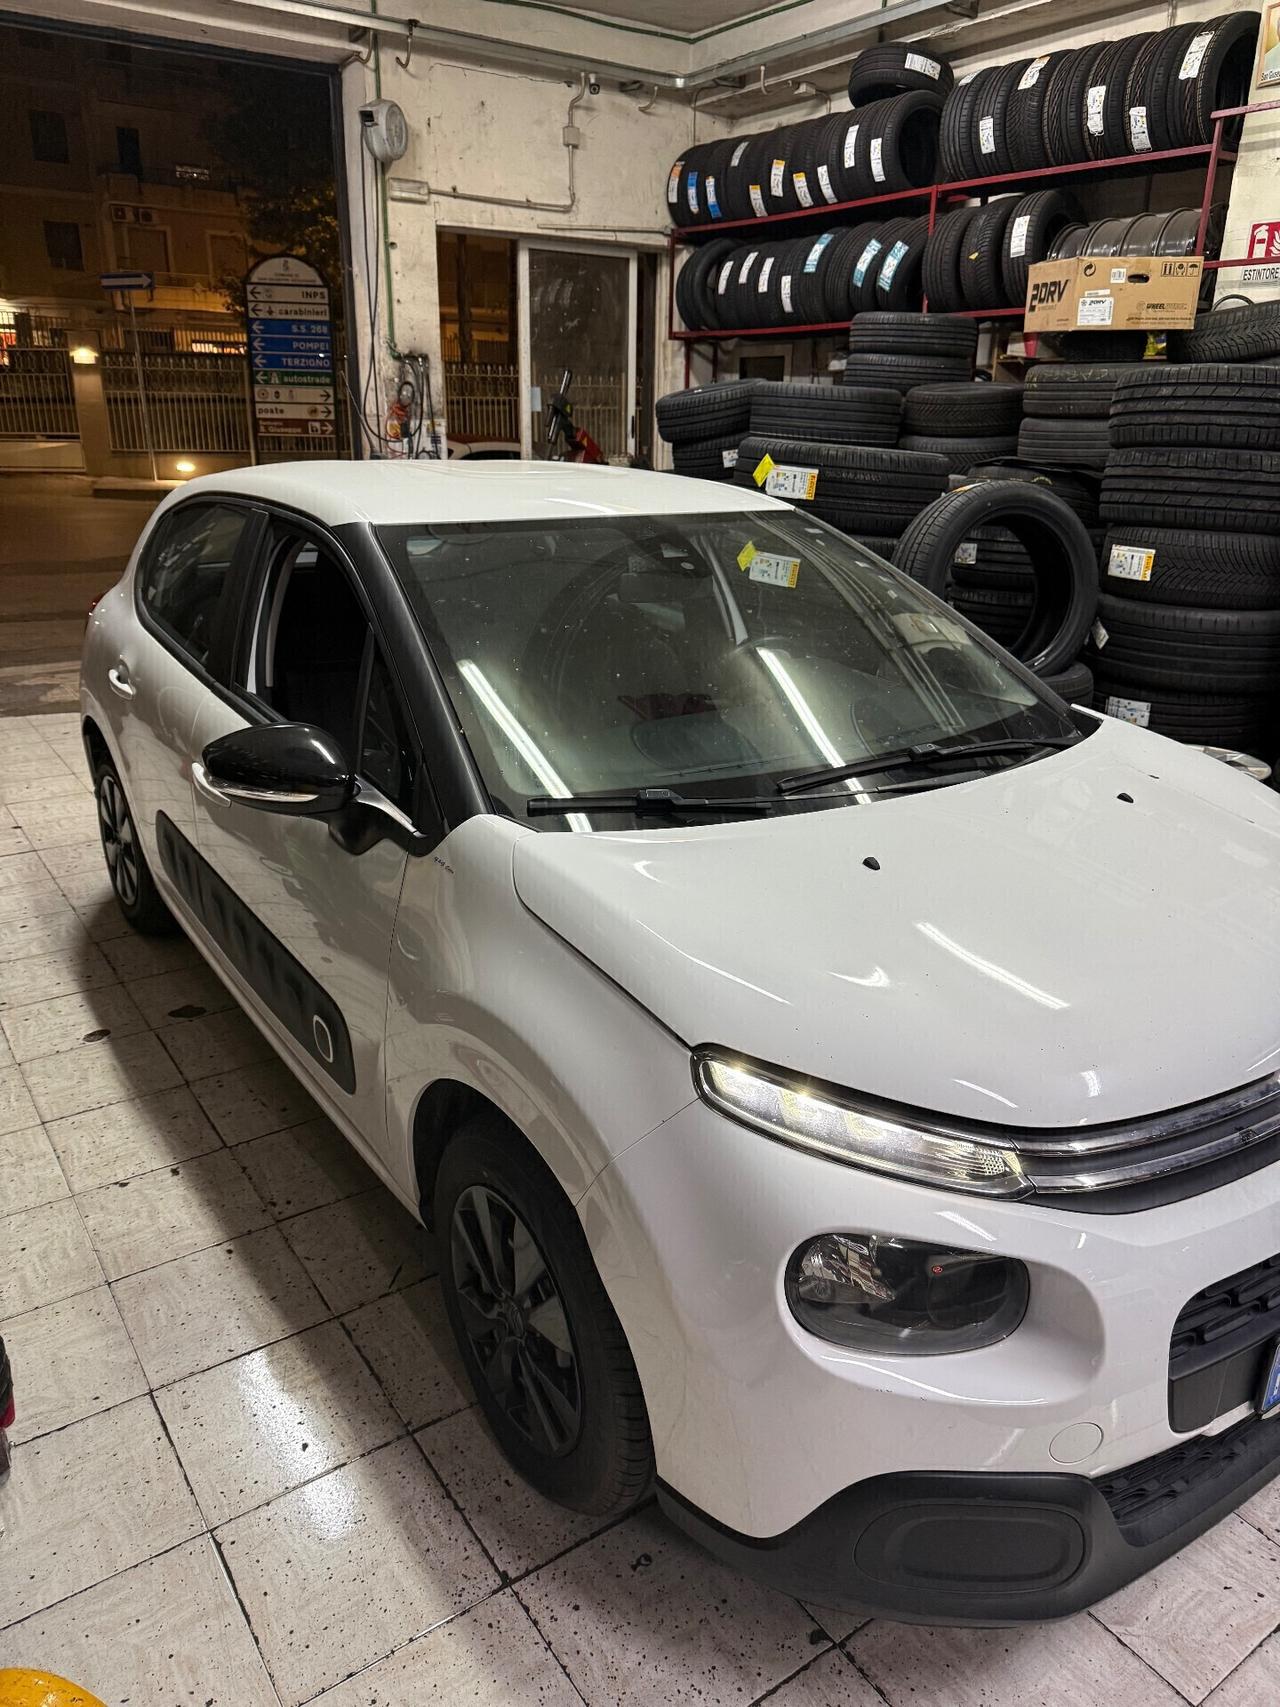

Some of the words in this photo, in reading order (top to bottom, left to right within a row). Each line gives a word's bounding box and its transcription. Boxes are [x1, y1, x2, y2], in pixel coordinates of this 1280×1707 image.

[1243, 267, 1280, 281] ESTINTORE
[301, 290, 326, 299] INPS
[278, 306, 327, 316] carabinieri
[292, 341, 329, 350] POMPEI
[281, 357, 330, 367] TERZIGNO
[283, 374, 331, 384] autostrade
[257, 405, 285, 416] poste
